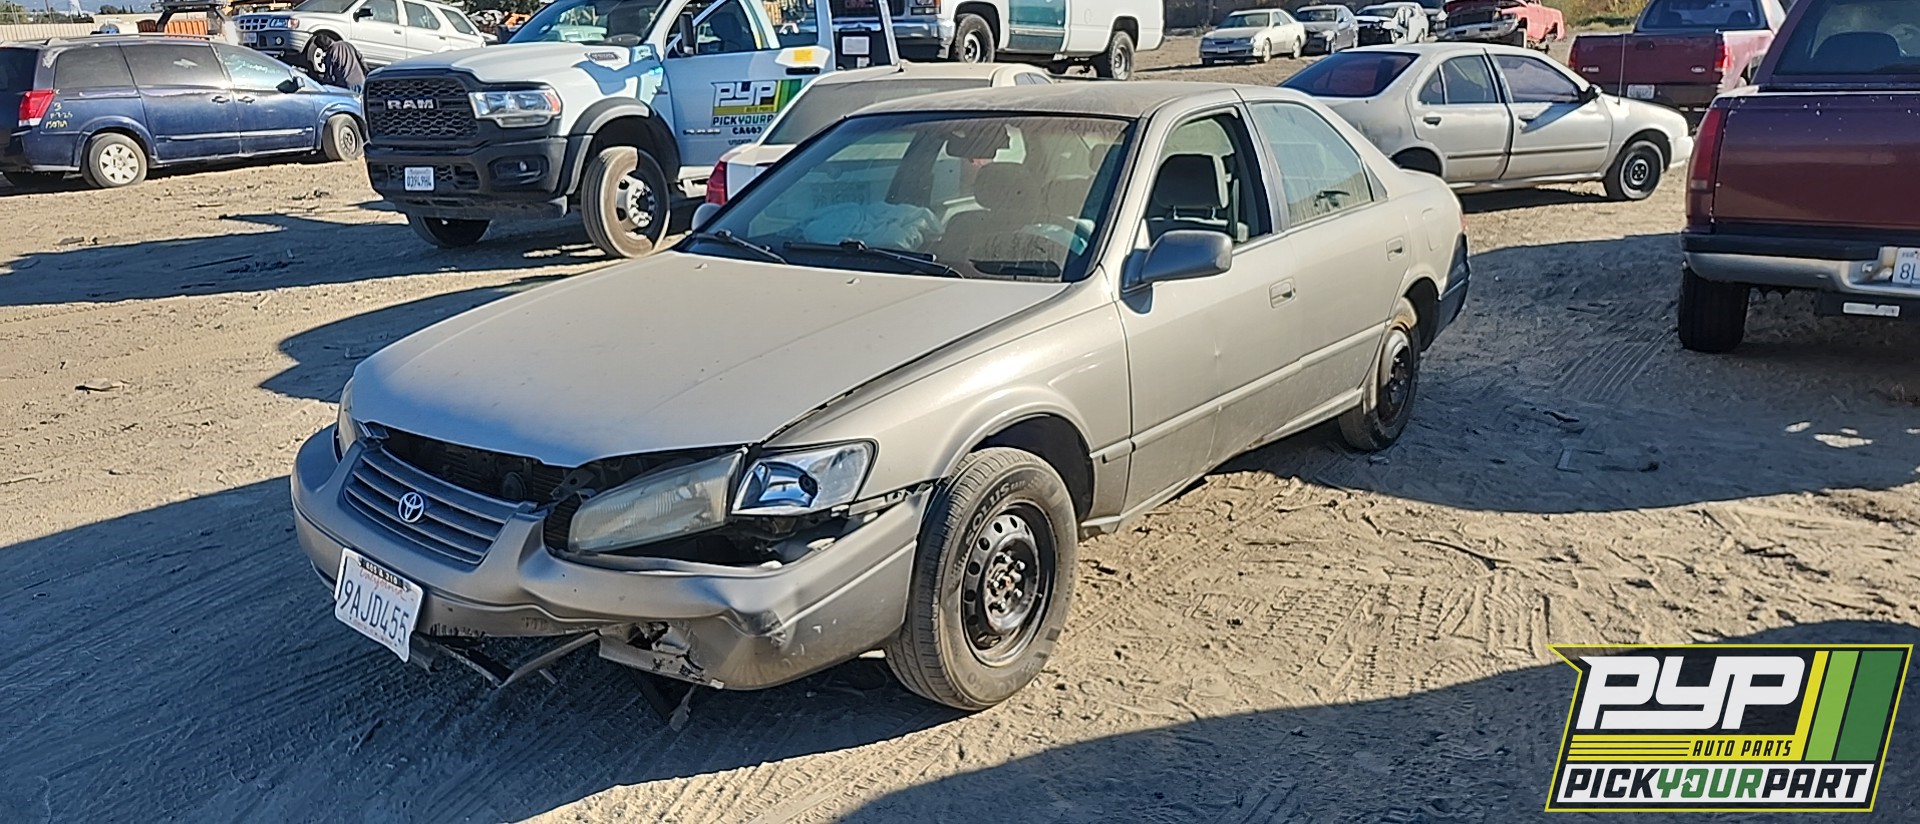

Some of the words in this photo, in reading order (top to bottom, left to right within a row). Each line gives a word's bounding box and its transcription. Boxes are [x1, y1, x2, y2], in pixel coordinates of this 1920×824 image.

[387, 99, 434, 110] RAM
[711, 81, 776, 107] PYP
[966, 482, 1011, 545] SOLUS
[340, 580, 409, 645] 9AJD455
